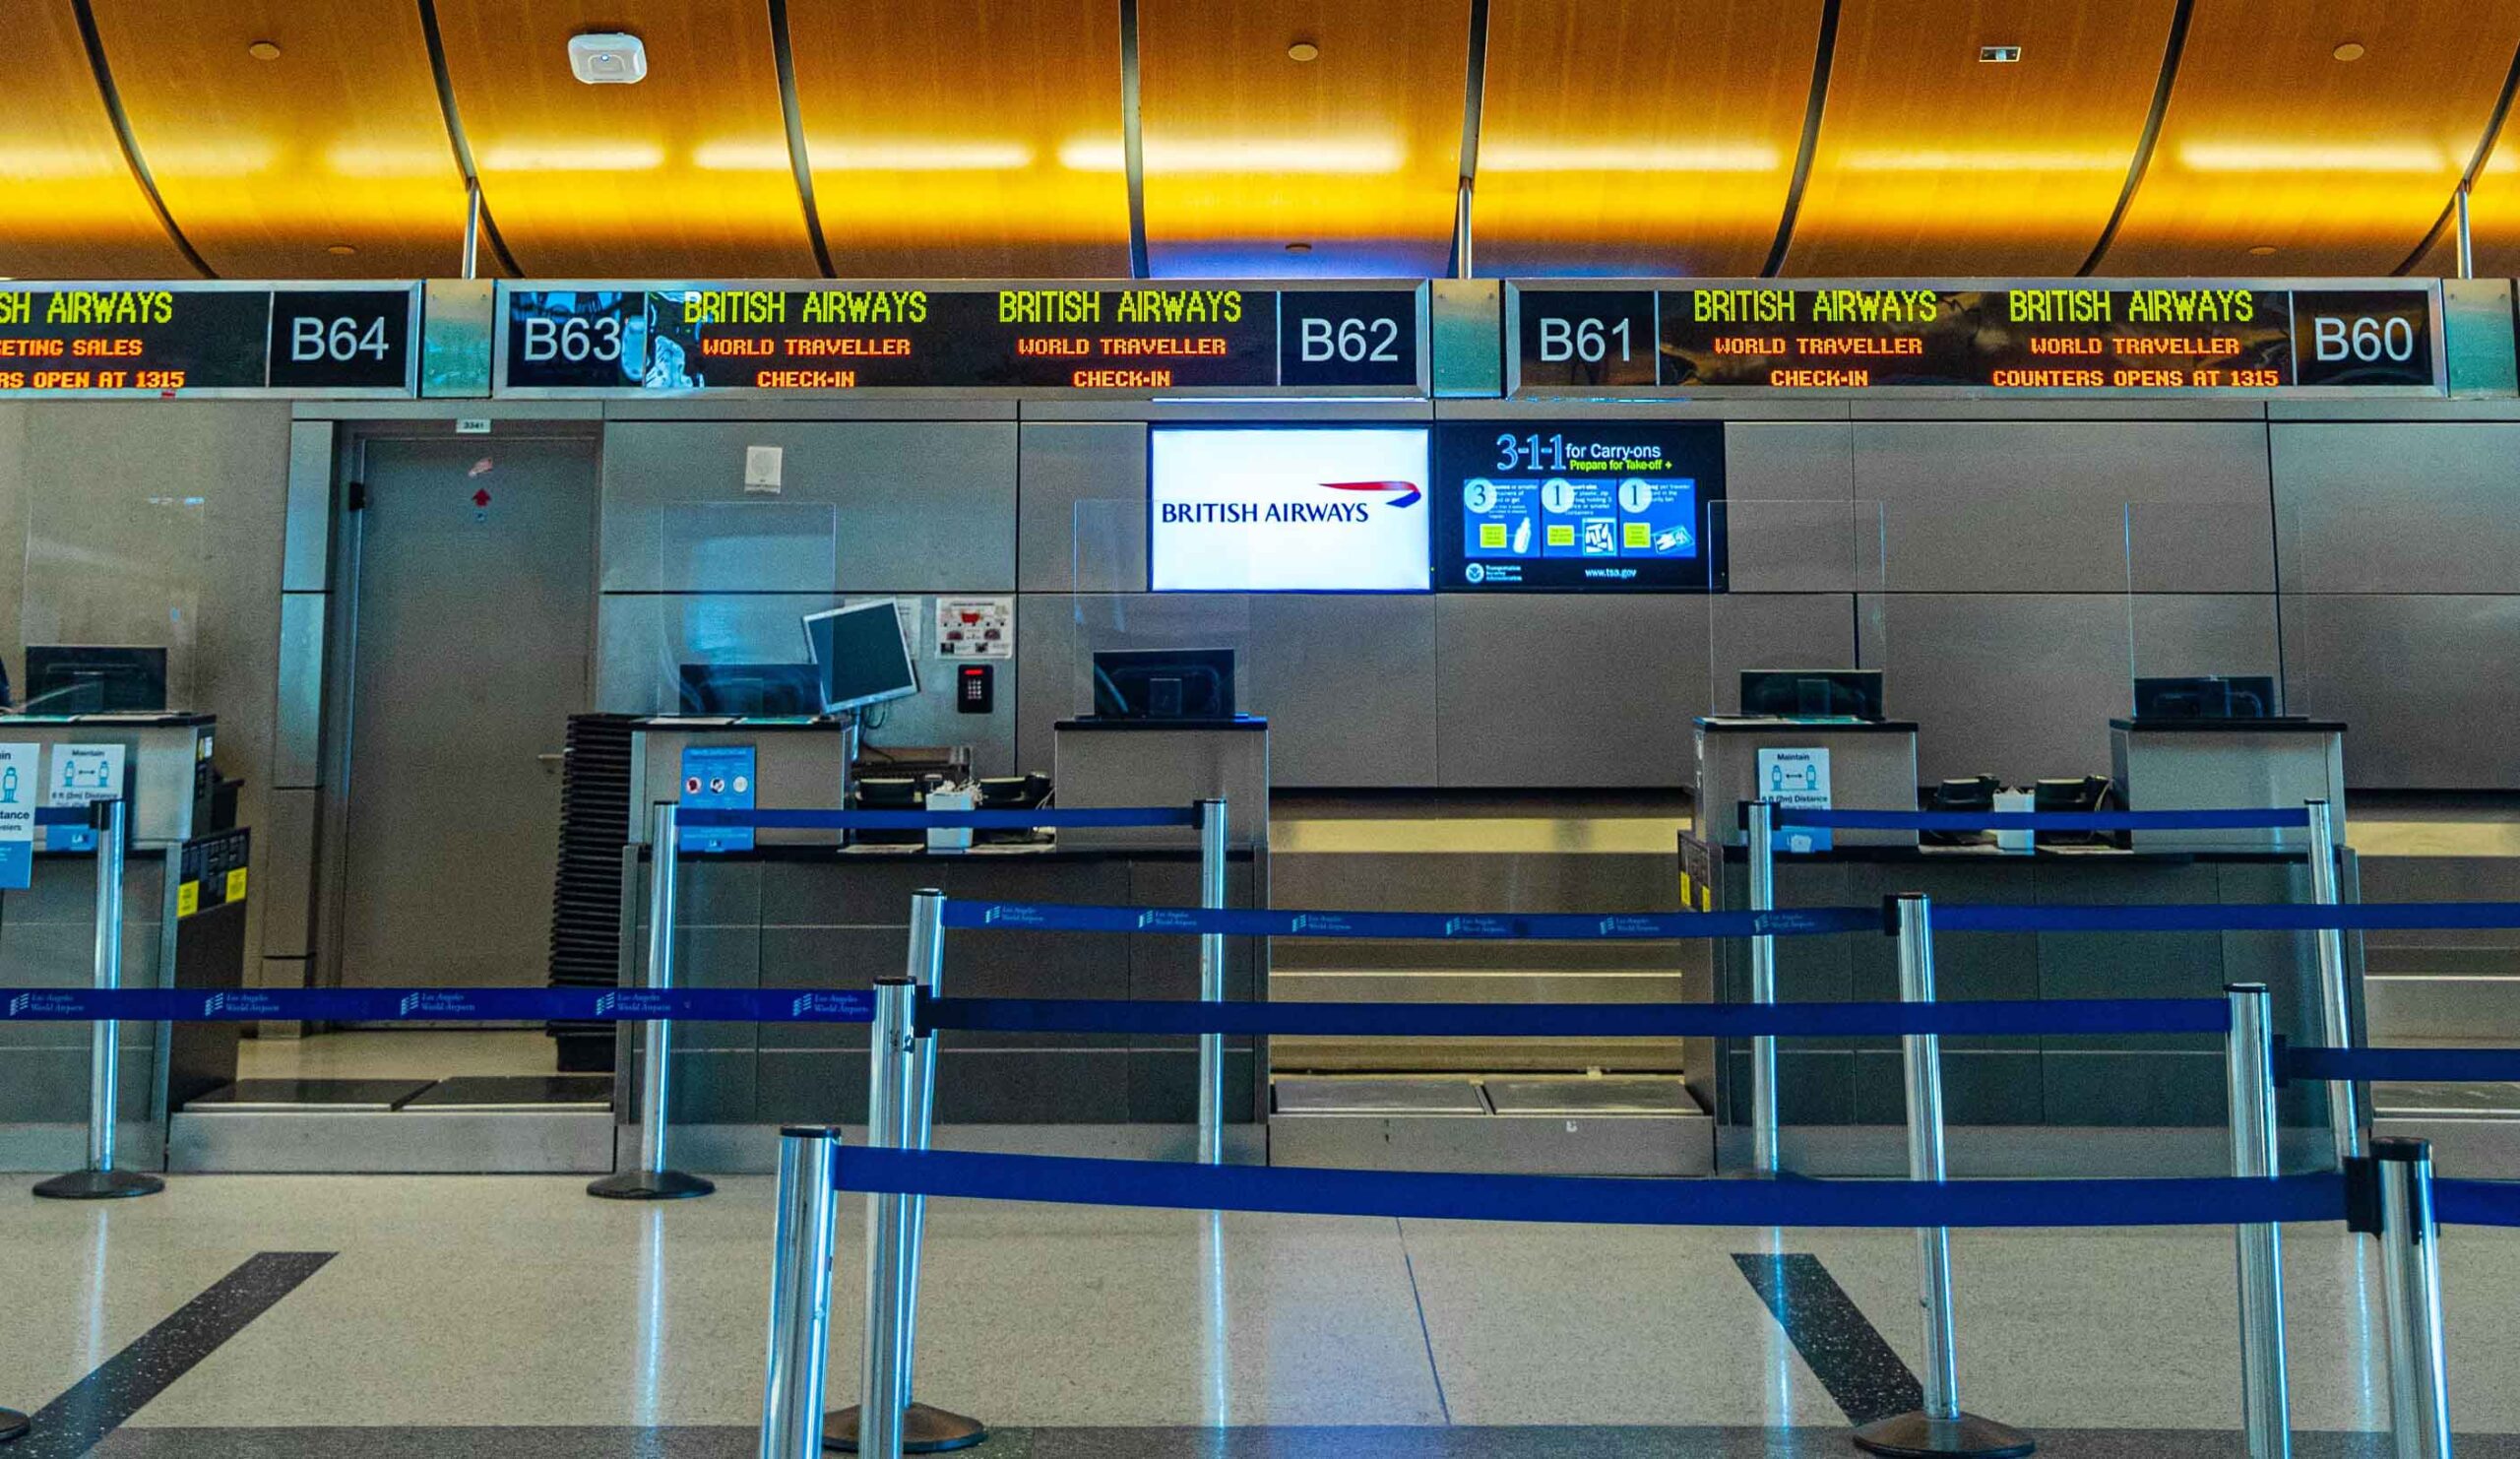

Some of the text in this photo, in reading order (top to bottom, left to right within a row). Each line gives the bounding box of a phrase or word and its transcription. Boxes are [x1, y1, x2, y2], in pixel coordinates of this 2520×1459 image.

[47, 290, 172, 323] AIRWAYS
[684, 291, 927, 323] BRITISH AIRWAYS
[999, 291, 1241, 323] BRITISH AIRWAYS
[1694, 290, 1937, 323] BRITISH AIRWAYS
[2009, 289, 2253, 322] BRITISH AIRWAYS
[0, 339, 143, 356] ETING SALES
[292, 317, 389, 360] B64
[525, 317, 621, 360] B63
[703, 339, 911, 355] WORLD TRAVELLER
[1018, 339, 1227, 355] WORLD TRAVELLER
[1301, 318, 1398, 362] B62
[1540, 318, 1630, 362] B61
[1715, 338, 1922, 354] WORLD TRAVELLER
[2031, 338, 2239, 354] WORLD TRAVELLER
[2314, 316, 2414, 361] B60
[33, 371, 91, 388] OPEN
[98, 371, 127, 388] AT
[136, 371, 185, 388] 1315
[756, 370, 854, 388] CHECK-IN
[1073, 371, 1171, 387] CHECK-IN
[1771, 370, 1868, 387] CHECK-IN
[1993, 370, 2279, 387] COUNTERS OPENS AT 1315
[1496, 433, 1662, 471] 3-1-1 for Carry-ons
[1570, 460, 1663, 473] Prepare for Take-off
[1474, 484, 1485, 506] 3
[1553, 485, 1561, 505] 1
[1632, 484, 1639, 505] 1
[1162, 503, 1368, 523] BRITISH AIRWAYS
[1585, 568, 1636, 579] www.tsa.gov
